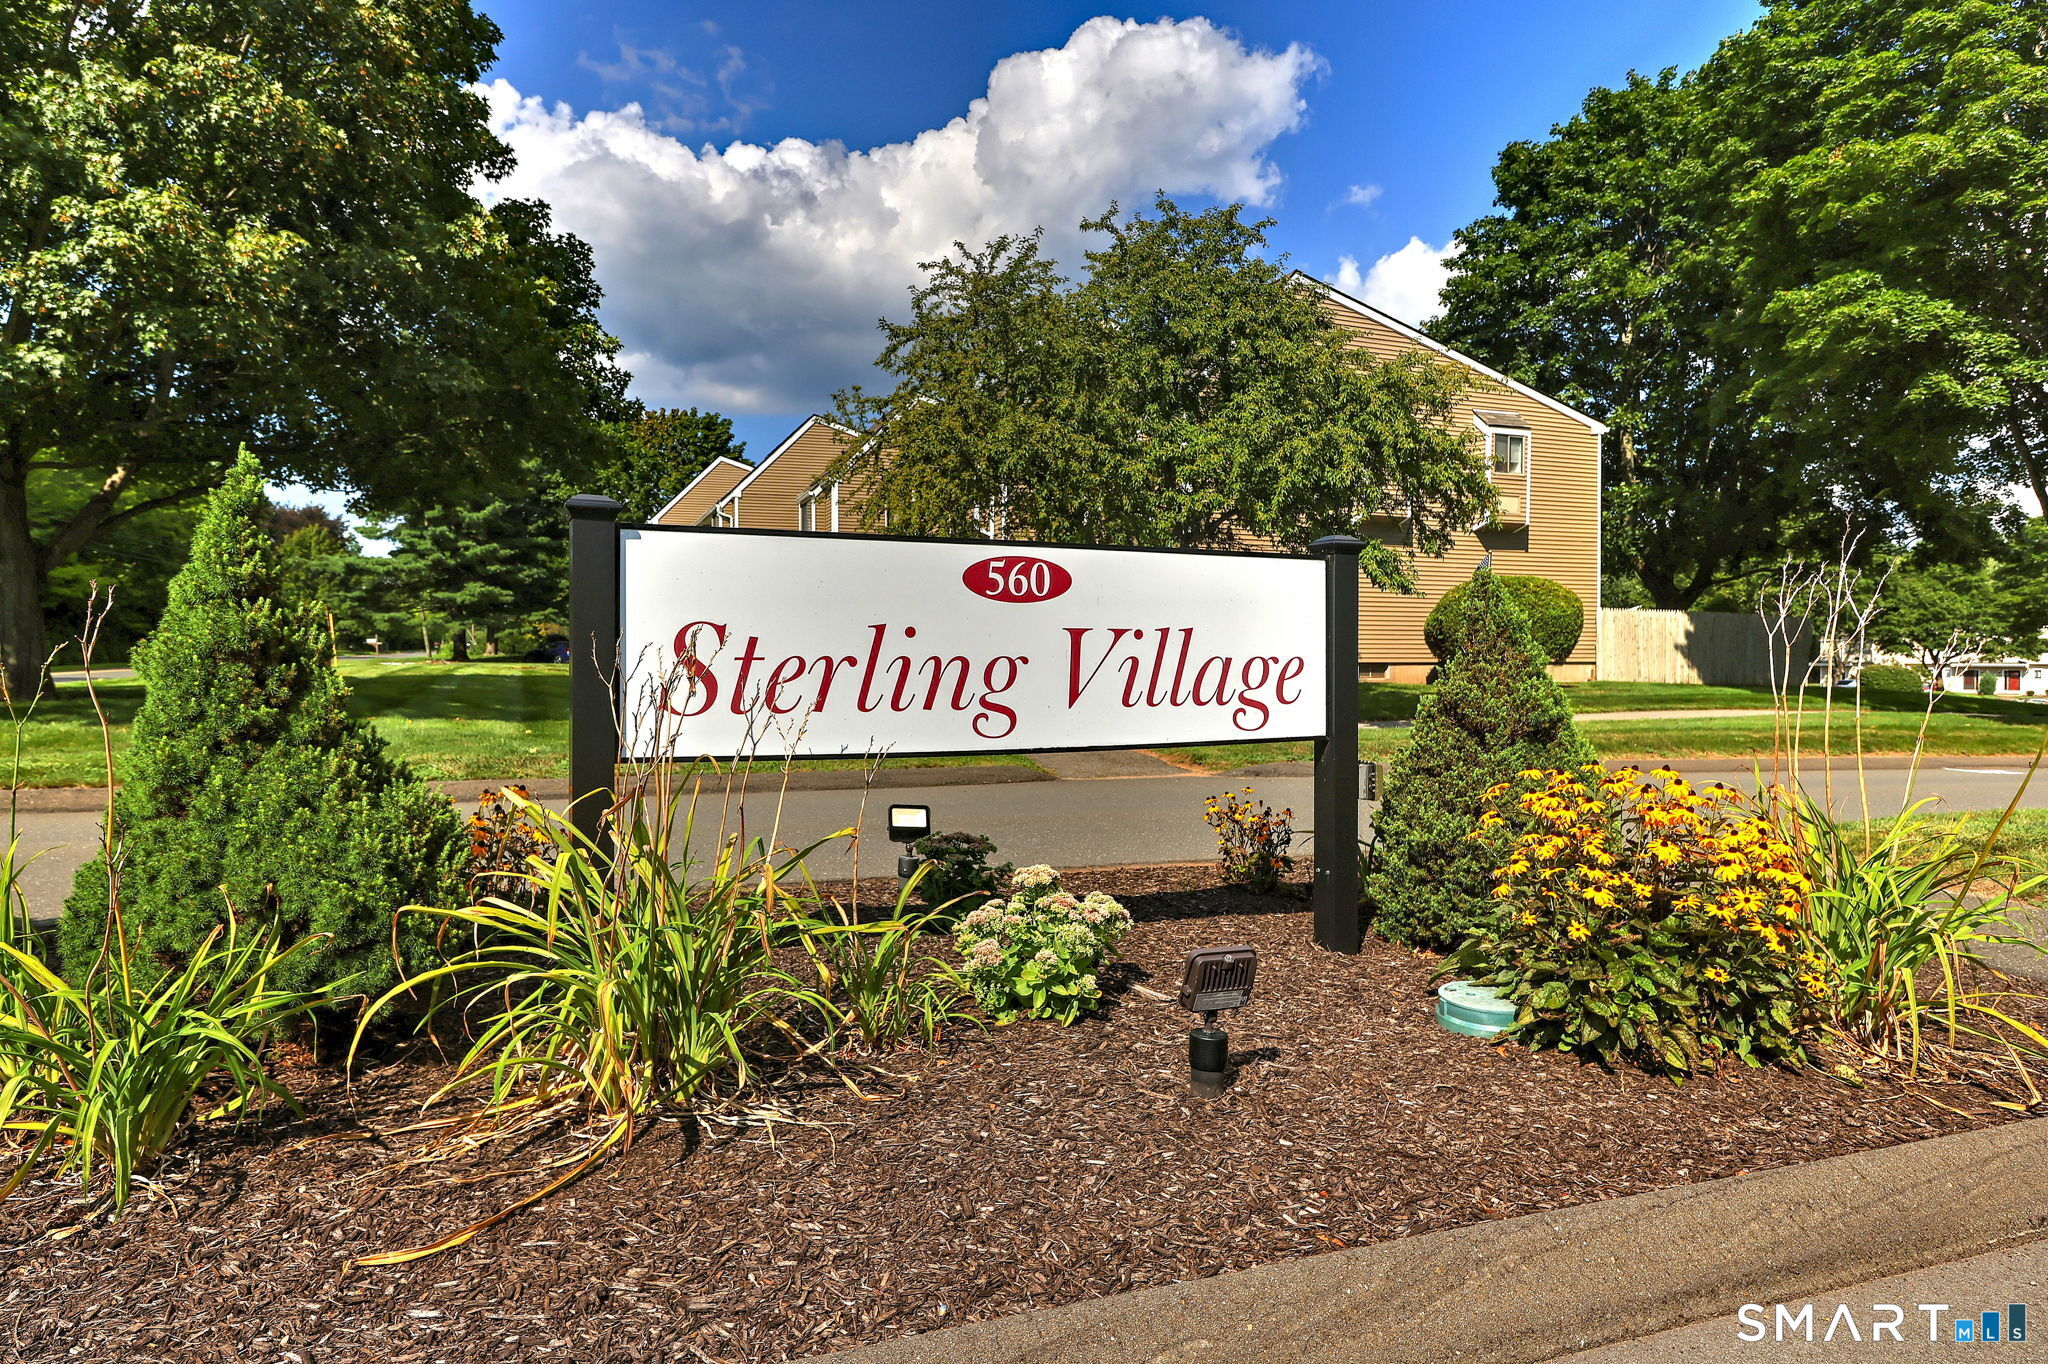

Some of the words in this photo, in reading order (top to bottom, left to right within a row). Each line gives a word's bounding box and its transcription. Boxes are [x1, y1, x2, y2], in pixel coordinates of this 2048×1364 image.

[985, 559, 1051, 597] 560
[661, 620, 1030, 739] Sterling
[1062, 626, 1305, 732] Village
